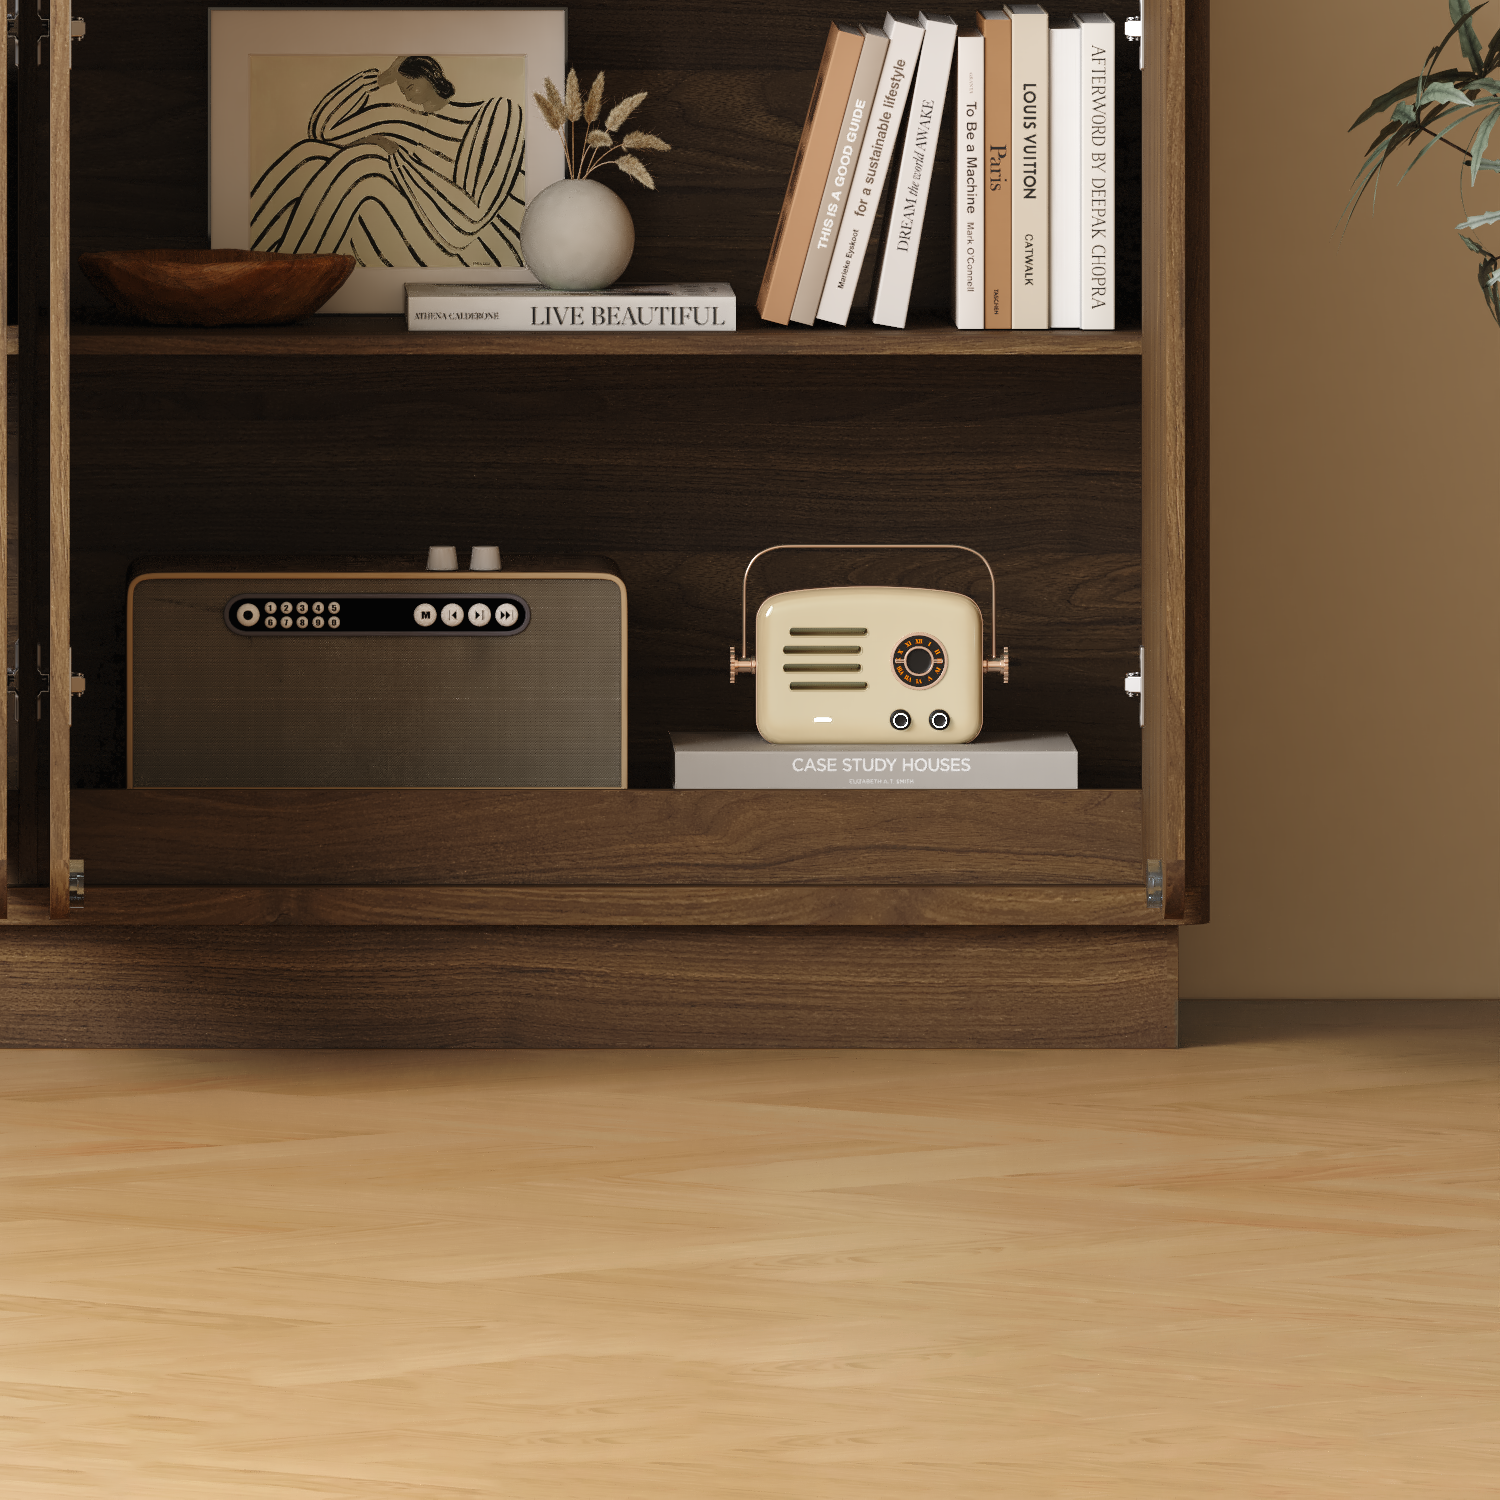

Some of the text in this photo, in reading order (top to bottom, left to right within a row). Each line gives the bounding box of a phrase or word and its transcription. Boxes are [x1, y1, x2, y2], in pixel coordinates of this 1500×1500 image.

[854, 59, 906, 217] for a sustainable lifestyle
[966, 101, 977, 214] To Be a Machine
[990, 145, 1007, 192] Paris
[1023, 83, 1037, 199] LOUIS VUITTON
[817, 98, 866, 249] THIS IS A GOOD GUIDE
[896, 198, 918, 252] DREAM
[907, 181, 920, 197] the
[915, 99, 935, 151] AWAKE
[1091, 45, 1107, 309] AFTERWORD BY DEEPAK CHOPRA
[837, 229, 860, 290] Marieke Eyskoot
[966, 222, 975, 292] Mark O'Connell
[1024, 233, 1034, 286] CATWALK
[414, 312, 447, 320] ATHENA
[531, 306, 725, 326] LIVE BEAUTIFUL
[421, 611, 431, 619] M
[792, 757, 971, 772] CASE STUDY HOUSES
